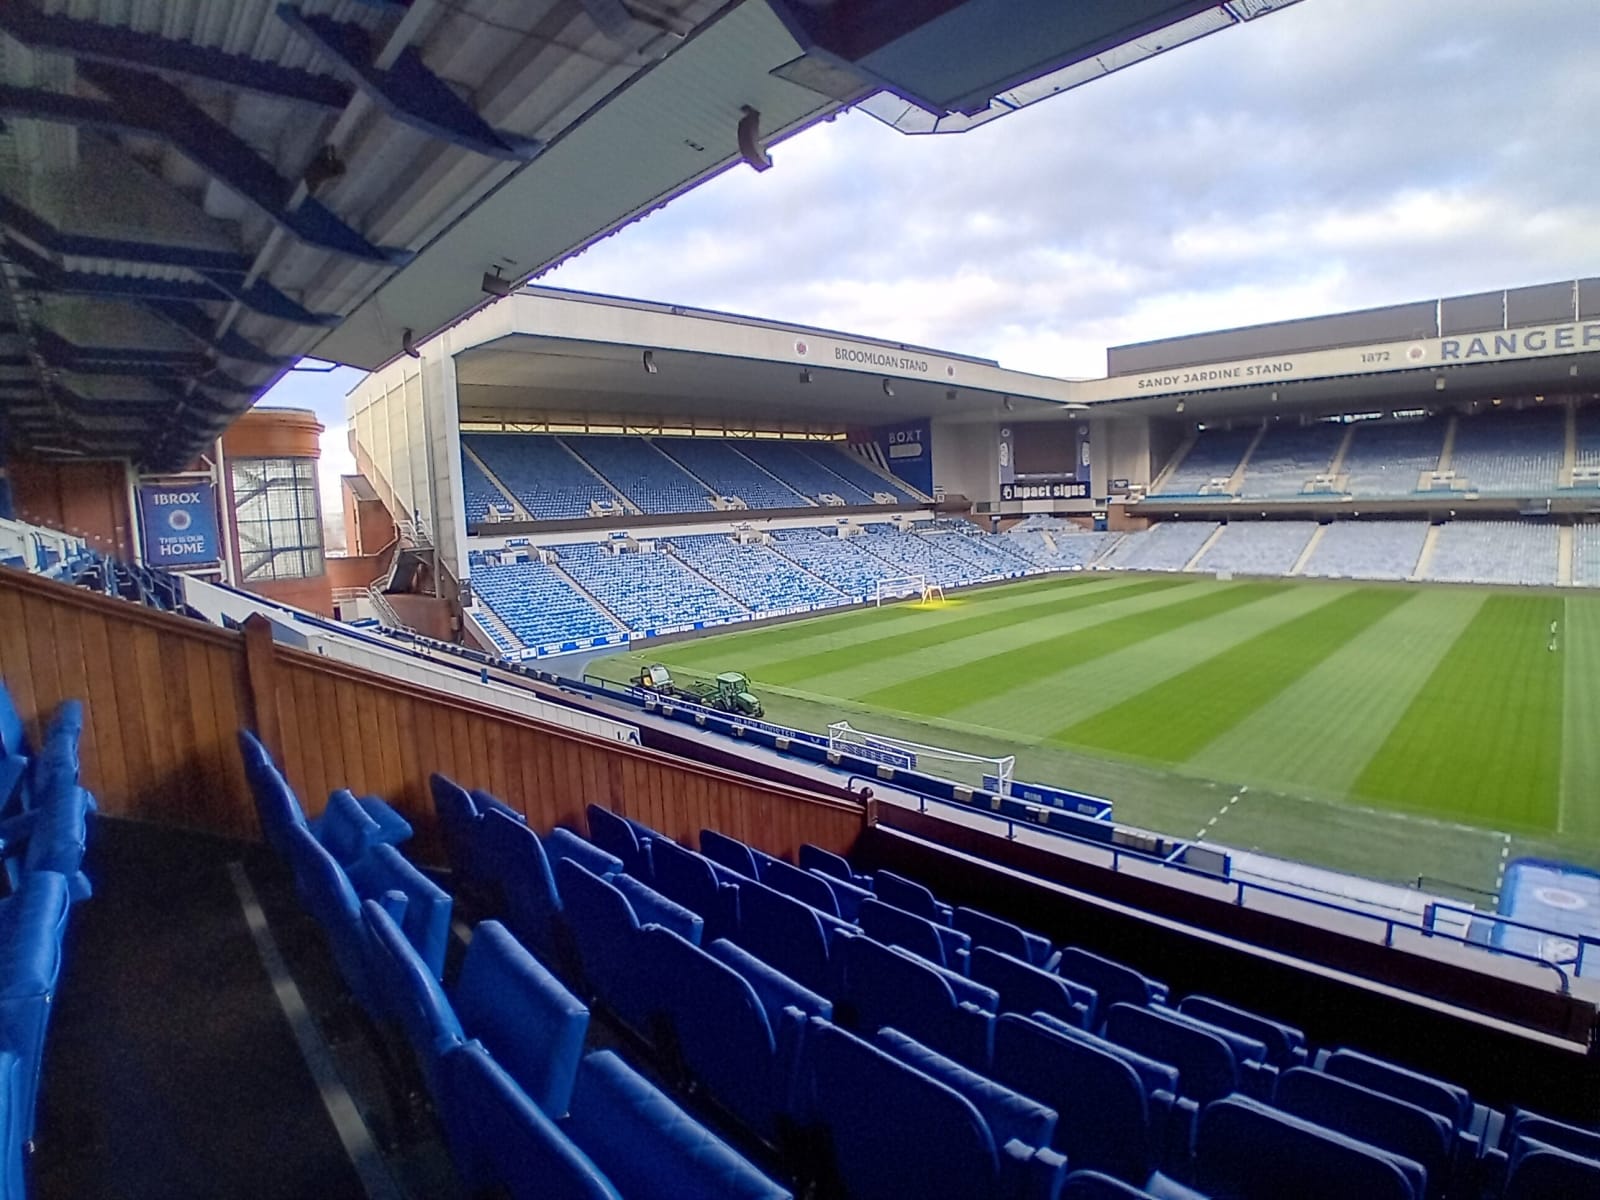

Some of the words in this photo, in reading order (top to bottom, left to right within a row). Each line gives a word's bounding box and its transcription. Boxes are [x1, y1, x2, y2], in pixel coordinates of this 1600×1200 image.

[834, 347, 899, 368] BROOMLOAN
[900, 359, 928, 373] STAND
[1361, 351, 1390, 363] 1872
[1138, 375, 1180, 389] SANDY
[1183, 367, 1241, 384] JARDINE
[1246, 361, 1293, 376] STAND
[889, 430, 922, 444] BOXT
[154, 493, 200, 505] IBROX
[161, 543, 205, 555] HOME
